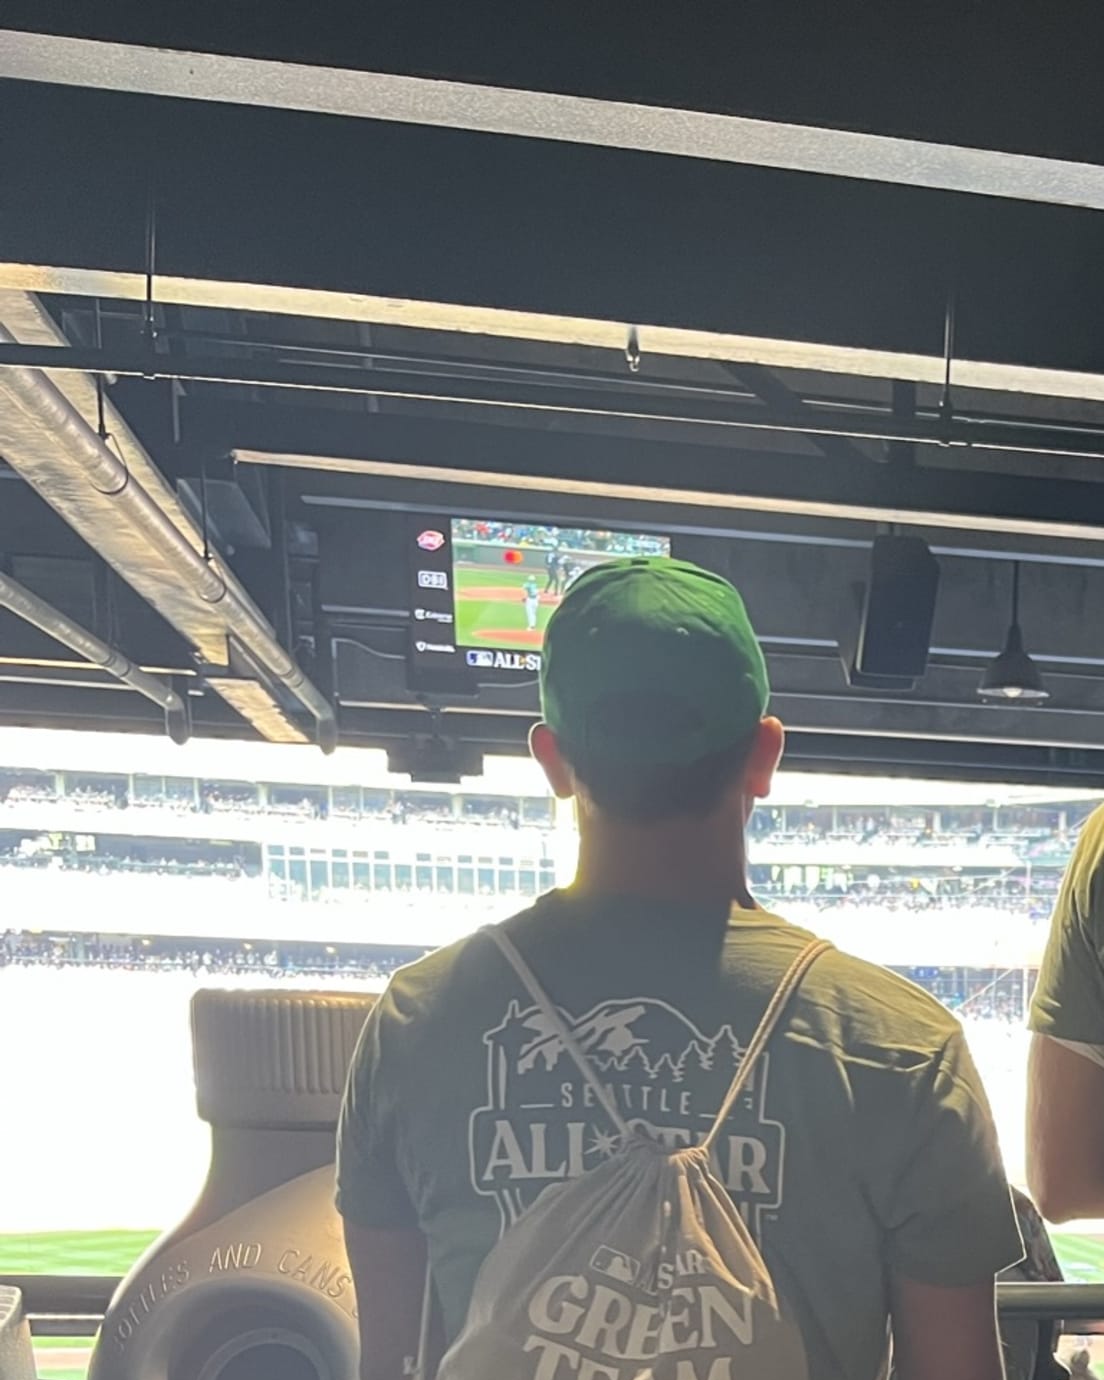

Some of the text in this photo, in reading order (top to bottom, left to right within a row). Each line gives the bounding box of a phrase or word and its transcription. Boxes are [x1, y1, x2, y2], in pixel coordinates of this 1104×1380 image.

[209, 1243, 262, 1273] AND
[277, 1250, 352, 1299] CANS
[528, 1274, 754, 1360] GREEN
